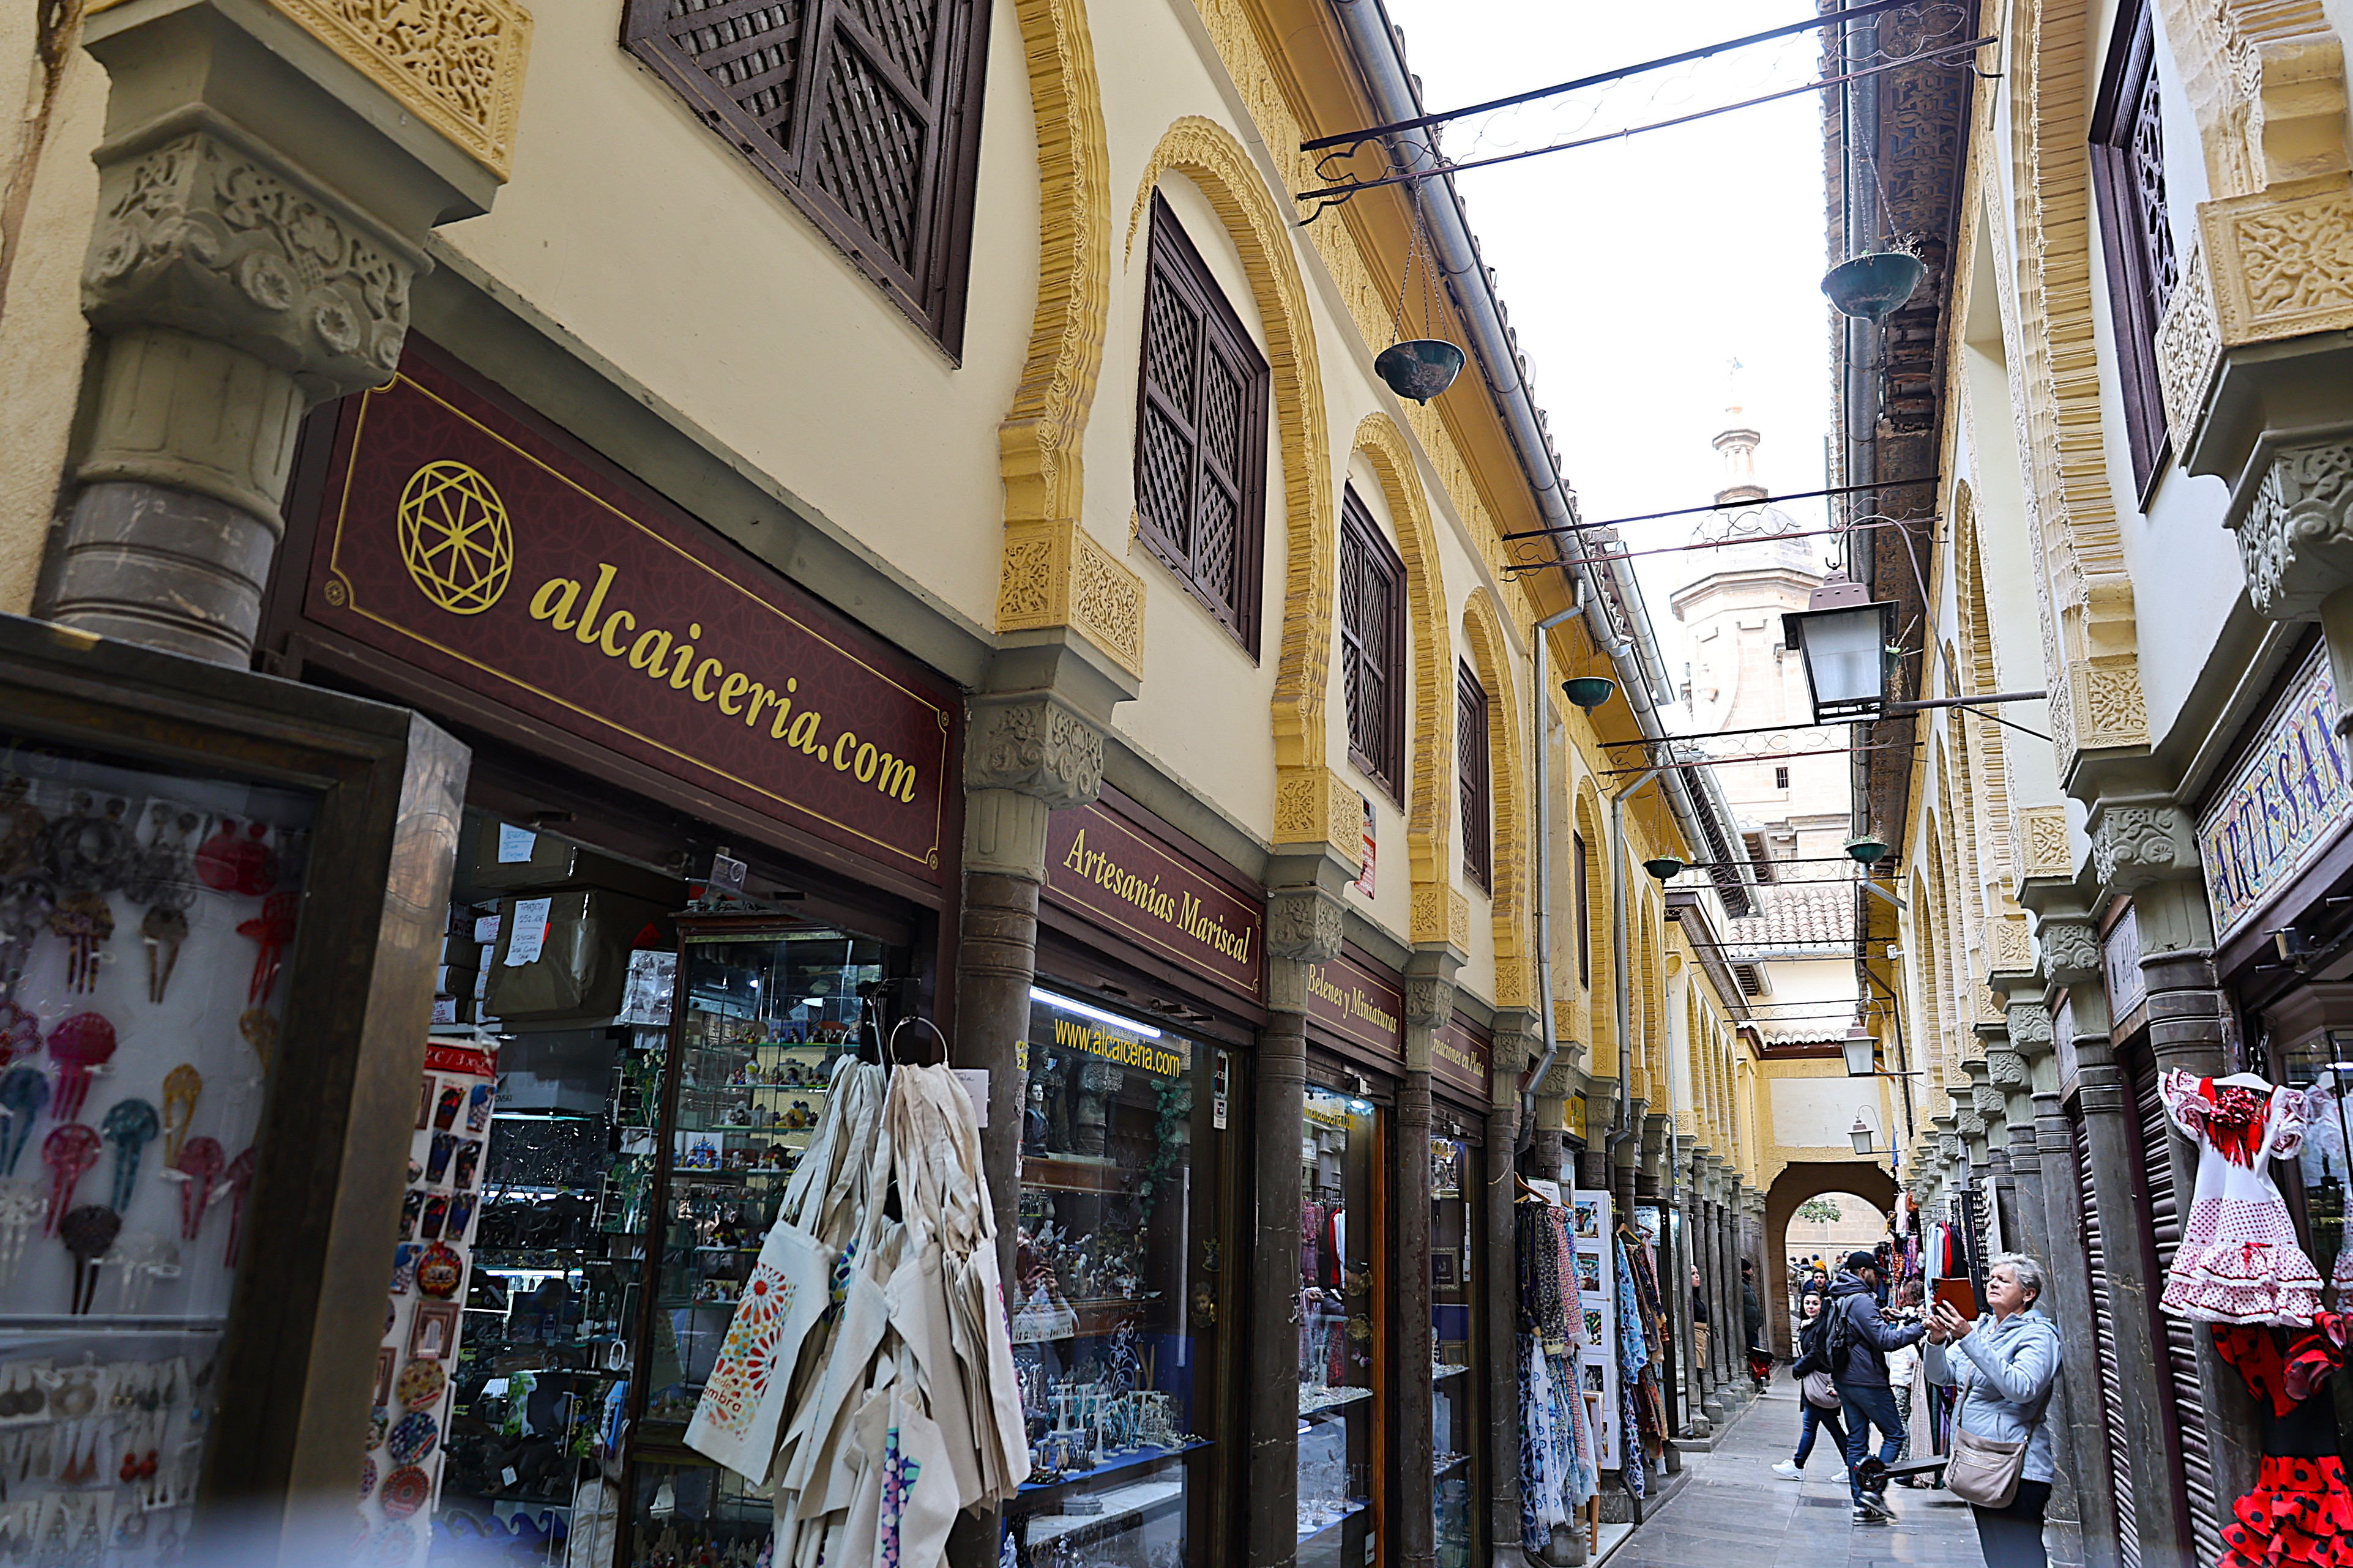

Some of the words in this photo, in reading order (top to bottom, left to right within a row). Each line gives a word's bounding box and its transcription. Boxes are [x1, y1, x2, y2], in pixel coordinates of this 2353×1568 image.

[529, 562, 917, 803] alcaiceria.com
[1063, 828, 1175, 923] Artesanías
[1176, 890, 1251, 964] Mariscal
[1307, 964, 1343, 1006] Belenes
[1343, 992, 1350, 1019] y
[1350, 986, 1397, 1034] Miniaturas
[1054, 1018, 1180, 1078] www.alcaiceria.com
[1461, 1053, 1469, 1071] en
[1469, 1051, 1485, 1078] Plata
